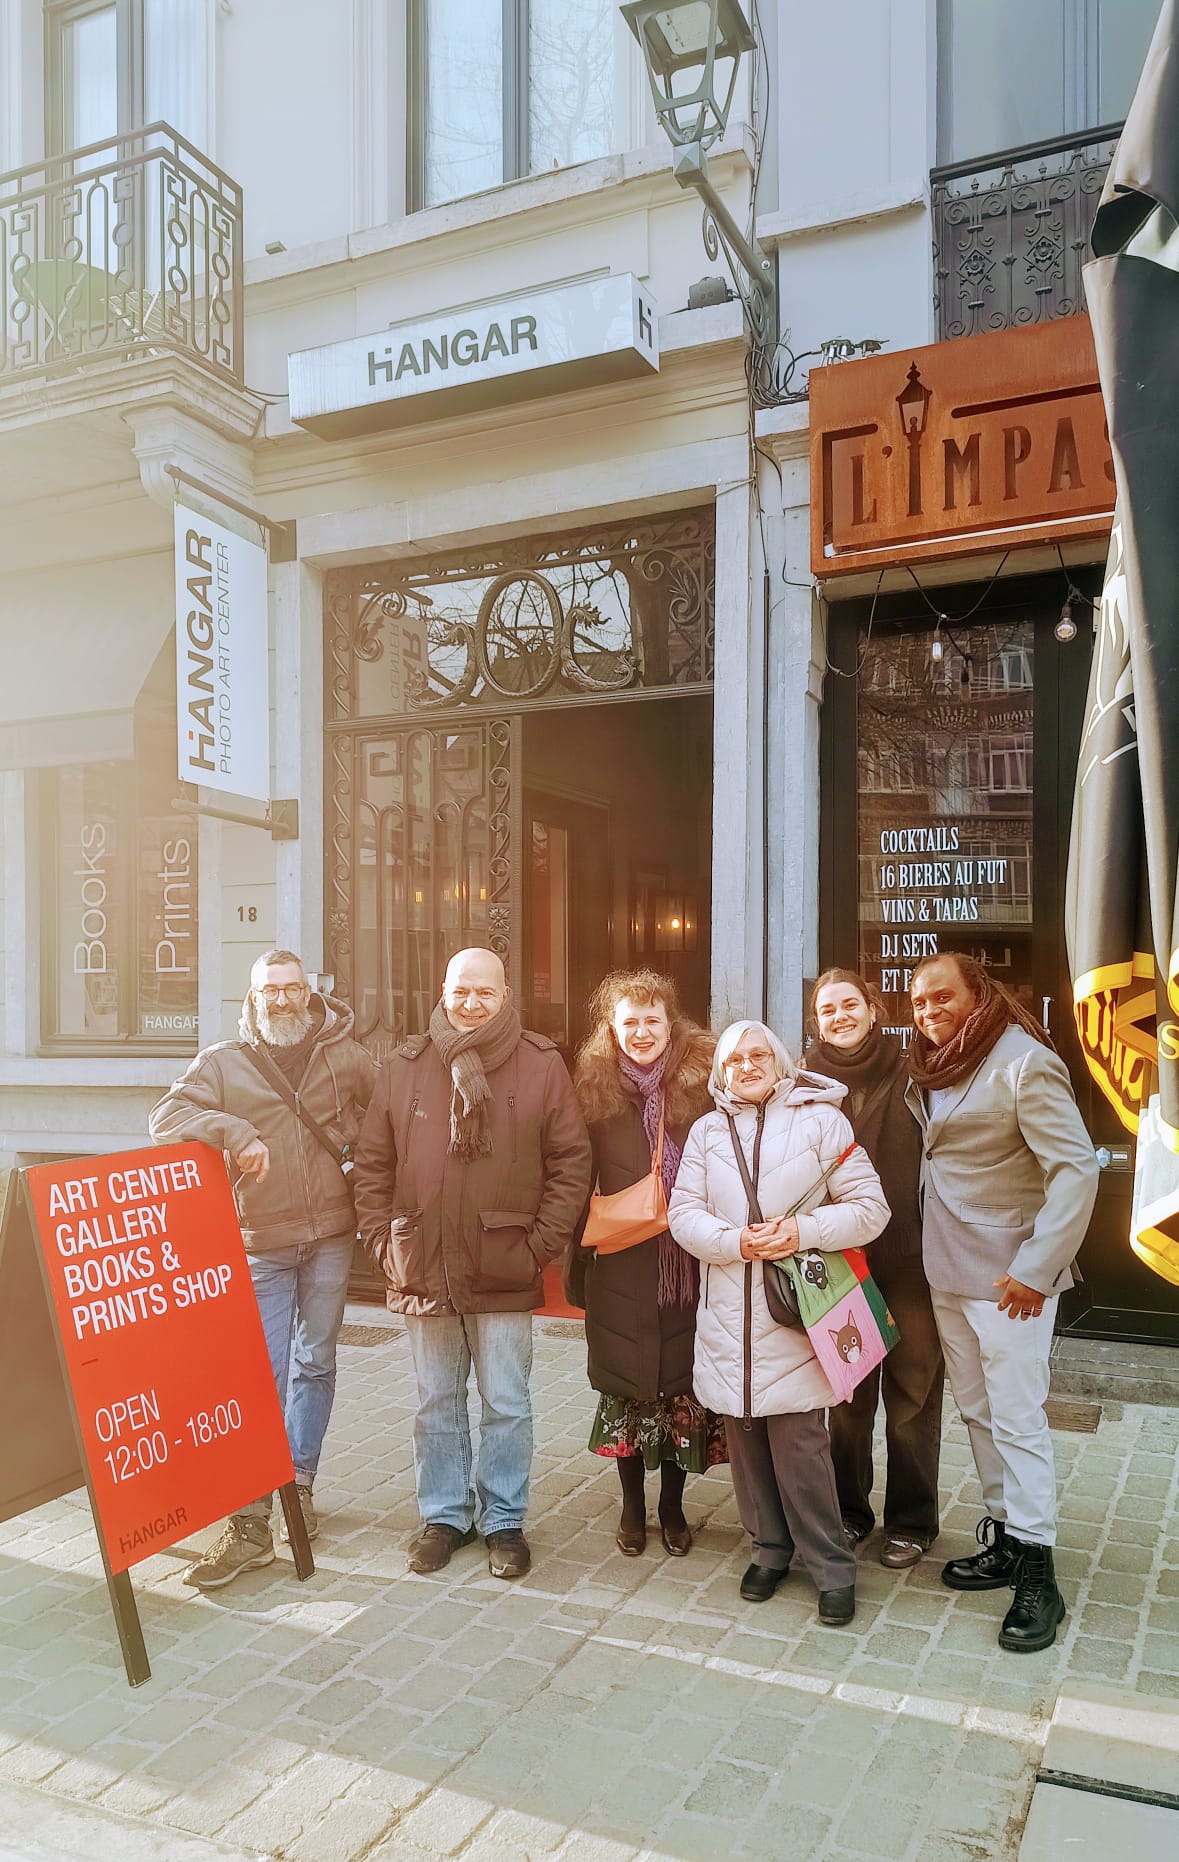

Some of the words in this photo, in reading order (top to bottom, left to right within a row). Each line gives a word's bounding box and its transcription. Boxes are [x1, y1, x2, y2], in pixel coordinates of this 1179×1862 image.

[367, 315, 539, 386] HANGAR
[216, 541, 232, 636] CENTER
[185, 528, 216, 772] HANGAR
[217, 646, 232, 689] ART
[217, 693, 232, 775] PHOTO
[880, 826, 959, 854] COCKTAILS
[73, 822, 107, 974] Books
[880, 864, 896, 889] 16
[899, 862, 951, 888] BIERES
[954, 860, 974, 886] AU
[977, 859, 1008, 885] FUT
[155, 838, 191, 973] Prints
[237, 906, 257, 922] 18
[880, 898, 916, 923] VINS
[918, 898, 931, 922] &
[932, 896, 979, 921] TAPAS
[880, 934, 899, 958] DJ
[902, 932, 938, 957] SETS
[880, 968, 901, 993] ET
[50, 1177, 99, 1217] ART
[107, 1159, 201, 1204] CENTER
[55, 1202, 167, 1257] GALLERY
[63, 1246, 155, 1299] BOOKS
[161, 1241, 181, 1272] &
[72, 1283, 168, 1340] PRINTS
[172, 1264, 232, 1308] SHOP
[95, 1389, 161, 1442] OPEN
[104, 1430, 168, 1484] 12:00
[186, 1399, 242, 1448] 18:00
[119, 1506, 188, 1554] HANGAR
